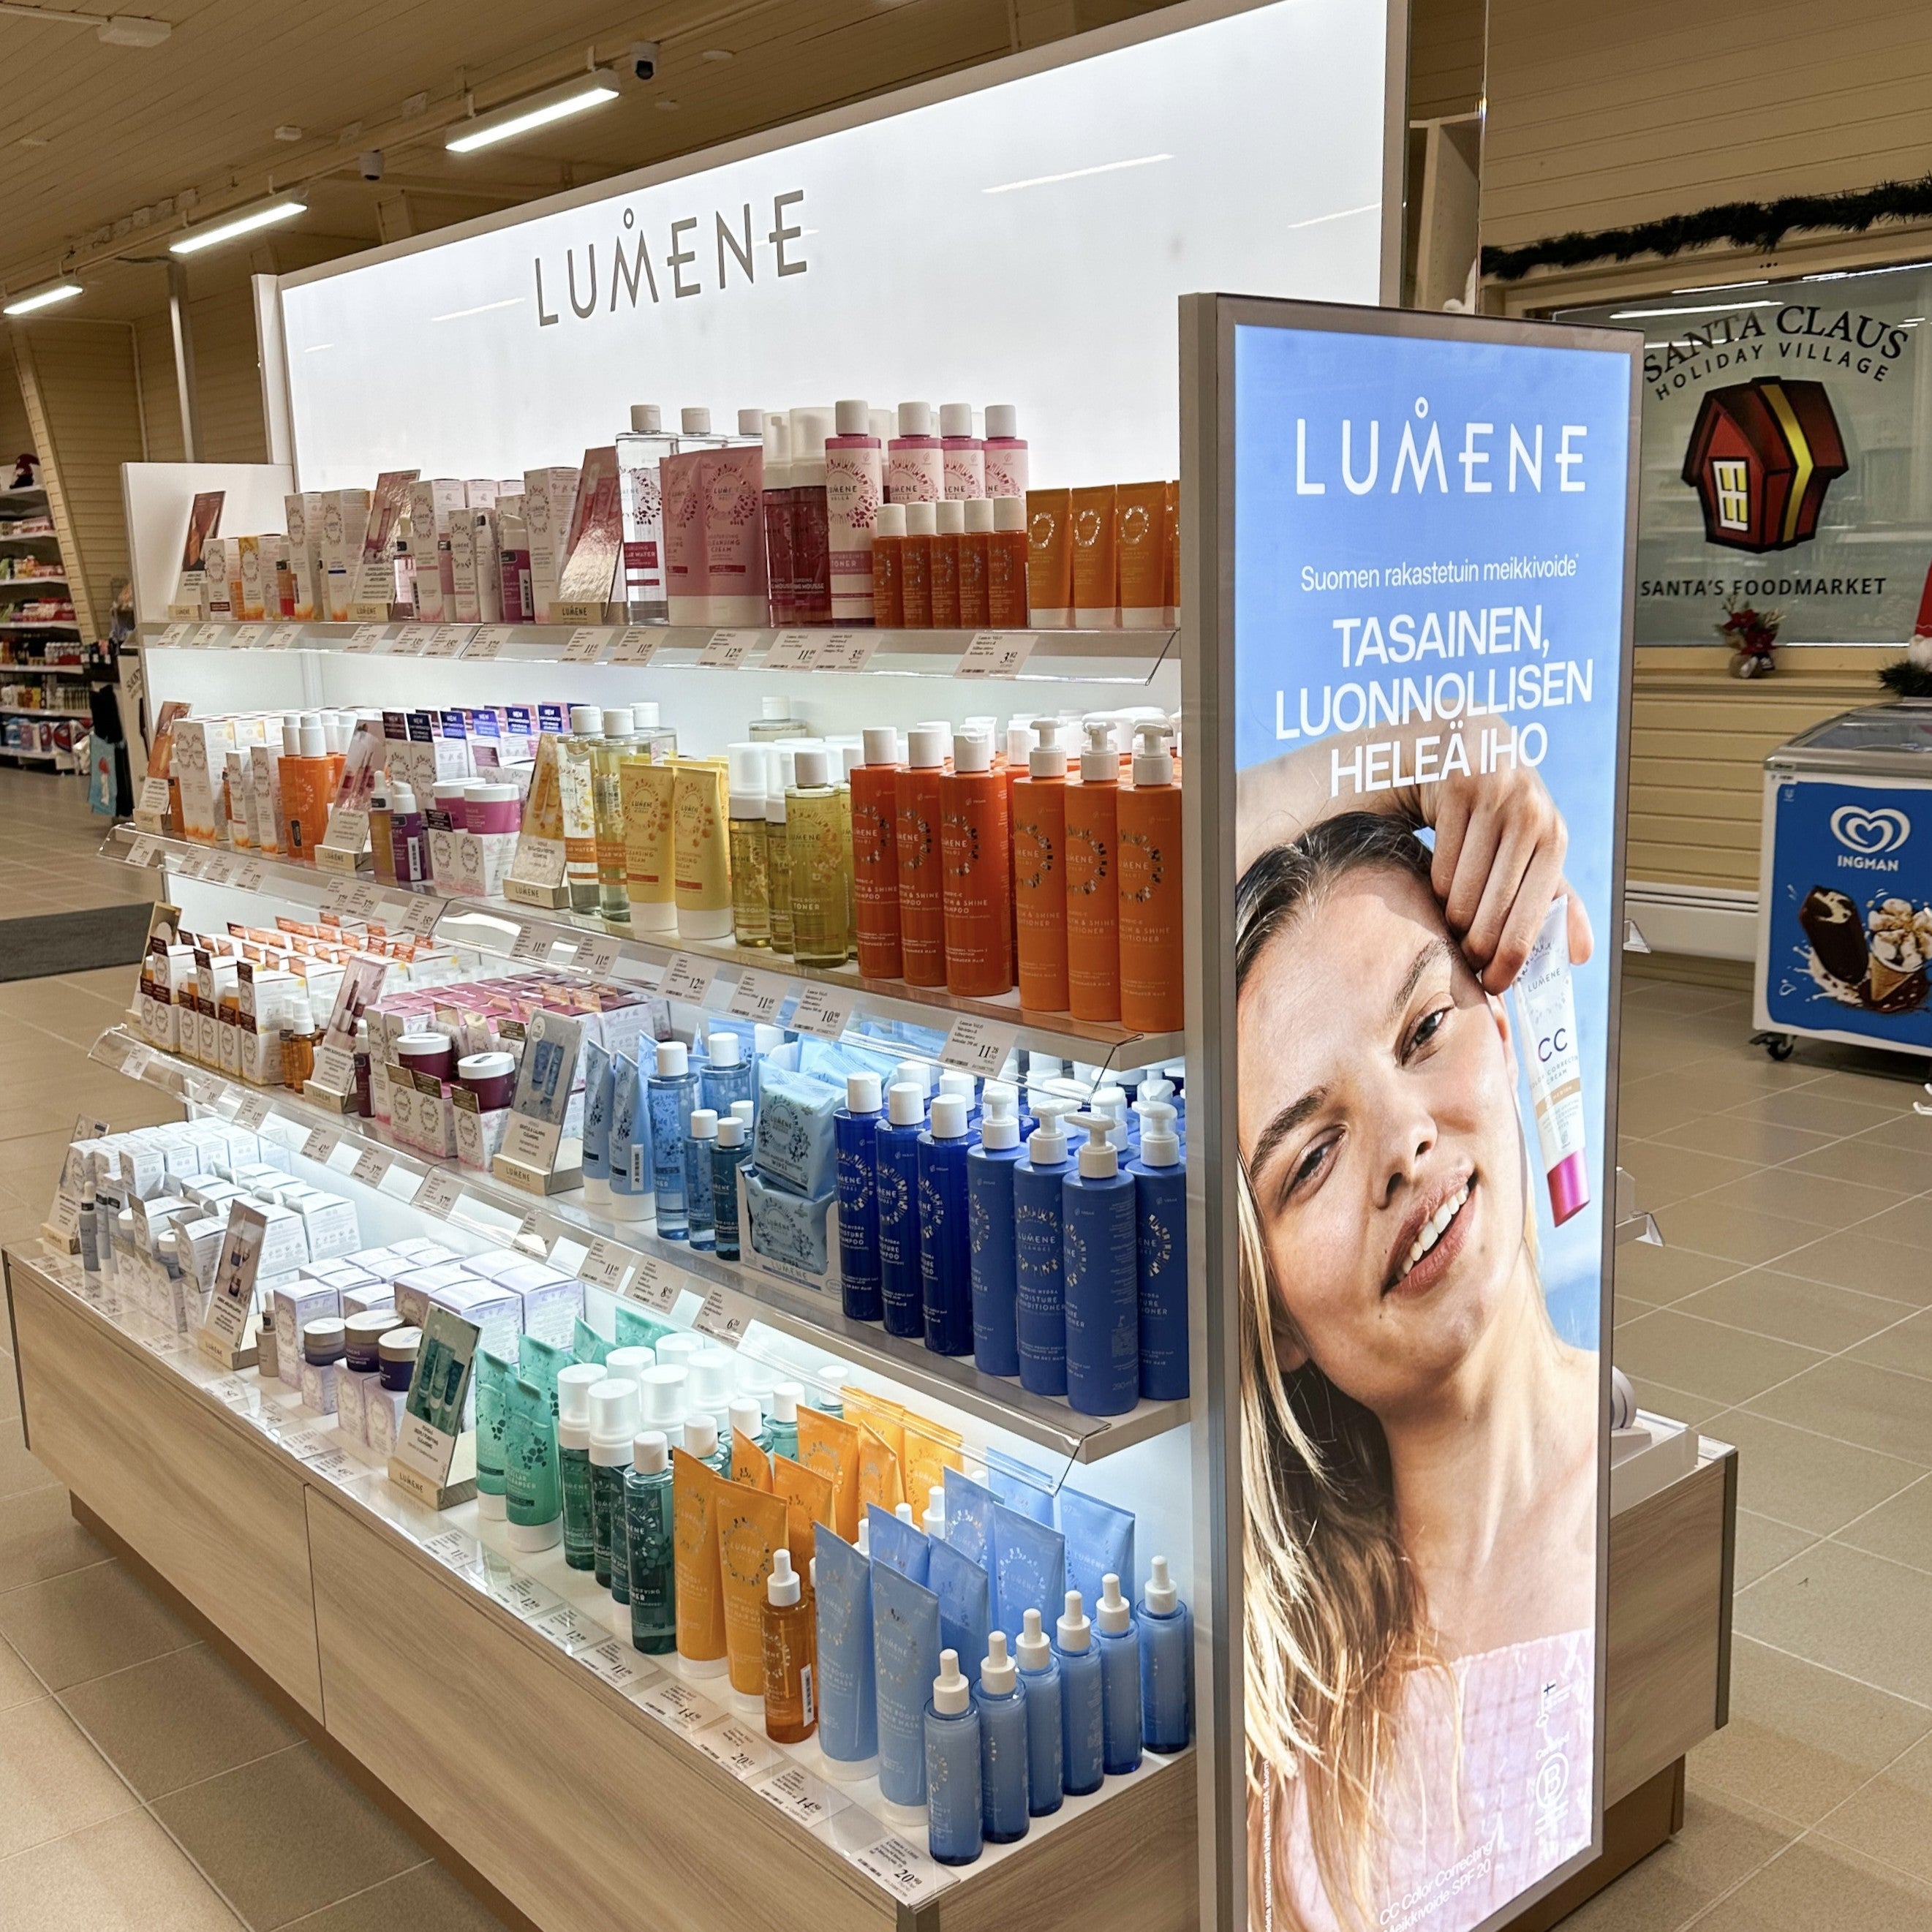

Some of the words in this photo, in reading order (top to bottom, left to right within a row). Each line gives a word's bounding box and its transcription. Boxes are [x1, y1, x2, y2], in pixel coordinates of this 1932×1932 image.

[535, 189, 807, 327] LUMENE
[1642, 310, 1766, 384] SANTA
[1776, 305, 1909, 361] CLAUS
[1654, 343, 1763, 401] HOLIDAY
[1778, 342, 1889, 382] VILLAGE
[1296, 396, 1588, 495] LUMENE
[1301, 565, 1380, 592] Suomen
[1384, 559, 1479, 588] rakastetuin
[1640, 579, 1724, 597] SANTA'S
[1732, 577, 1887, 596] FOODMARKET
[1332, 604, 1550, 668] TASAINEN,
[1275, 658, 1593, 740] LUONNOLLISEN
[1330, 721, 1471, 797] HELEÄ
[1480, 722, 1548, 774] IHO
[1837, 855, 1899, 872] INGMAN
[1528, 967, 1561, 993] LUMENE
[1538, 1027, 1568, 1063] CC
[894, 1868, 915, 1882] 20
[1435, 1840, 1494, 1887] Correcting
[1476, 1858, 1491, 1879] 20
